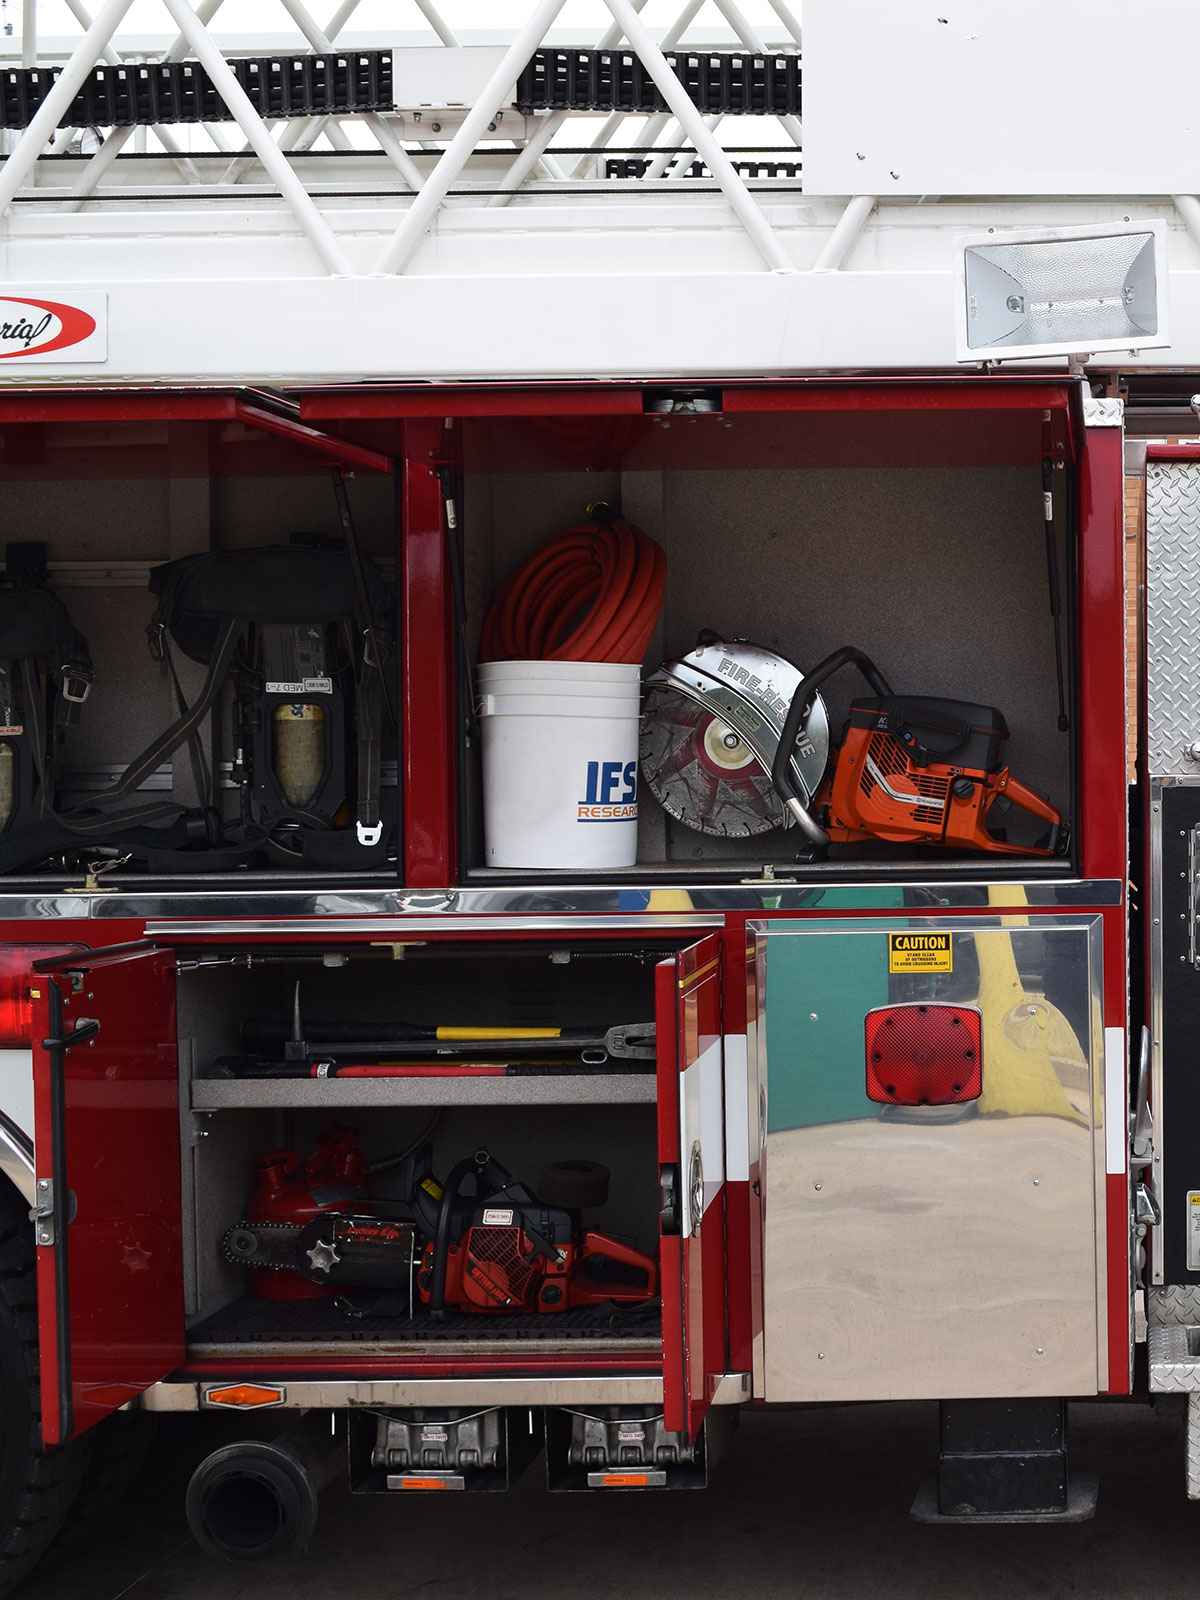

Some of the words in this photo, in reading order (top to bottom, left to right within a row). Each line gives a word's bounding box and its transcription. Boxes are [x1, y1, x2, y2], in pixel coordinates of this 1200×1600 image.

[0, 313, 52, 348] rial
[283, 684, 304, 692] MED
[895, 936, 946, 950] CAUTION
